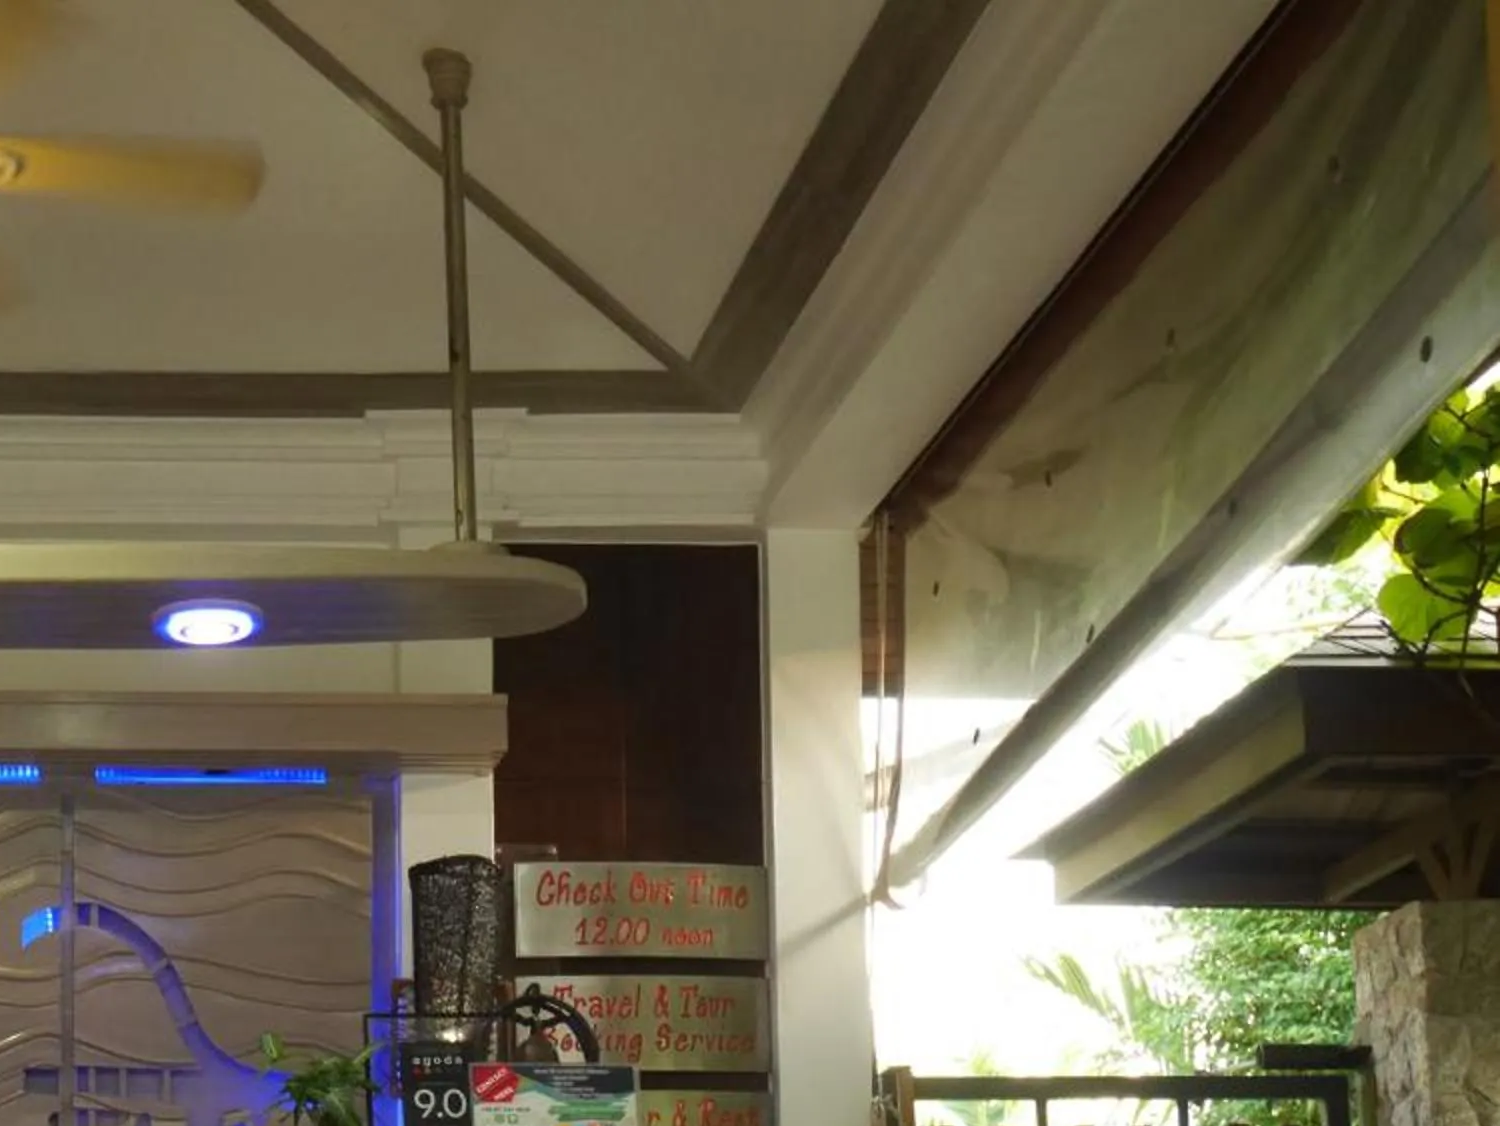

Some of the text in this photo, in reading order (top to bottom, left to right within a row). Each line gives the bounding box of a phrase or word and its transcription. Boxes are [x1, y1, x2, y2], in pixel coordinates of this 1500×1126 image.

[535, 868, 749, 909] Check Out Time
[574, 915, 715, 946] 12.00 noon
[552, 982, 736, 1019] Travel & Tour
[543, 1023, 755, 1062] oing Service
[412, 1055, 464, 1066] agoda
[414, 1088, 467, 1119] 9.0
